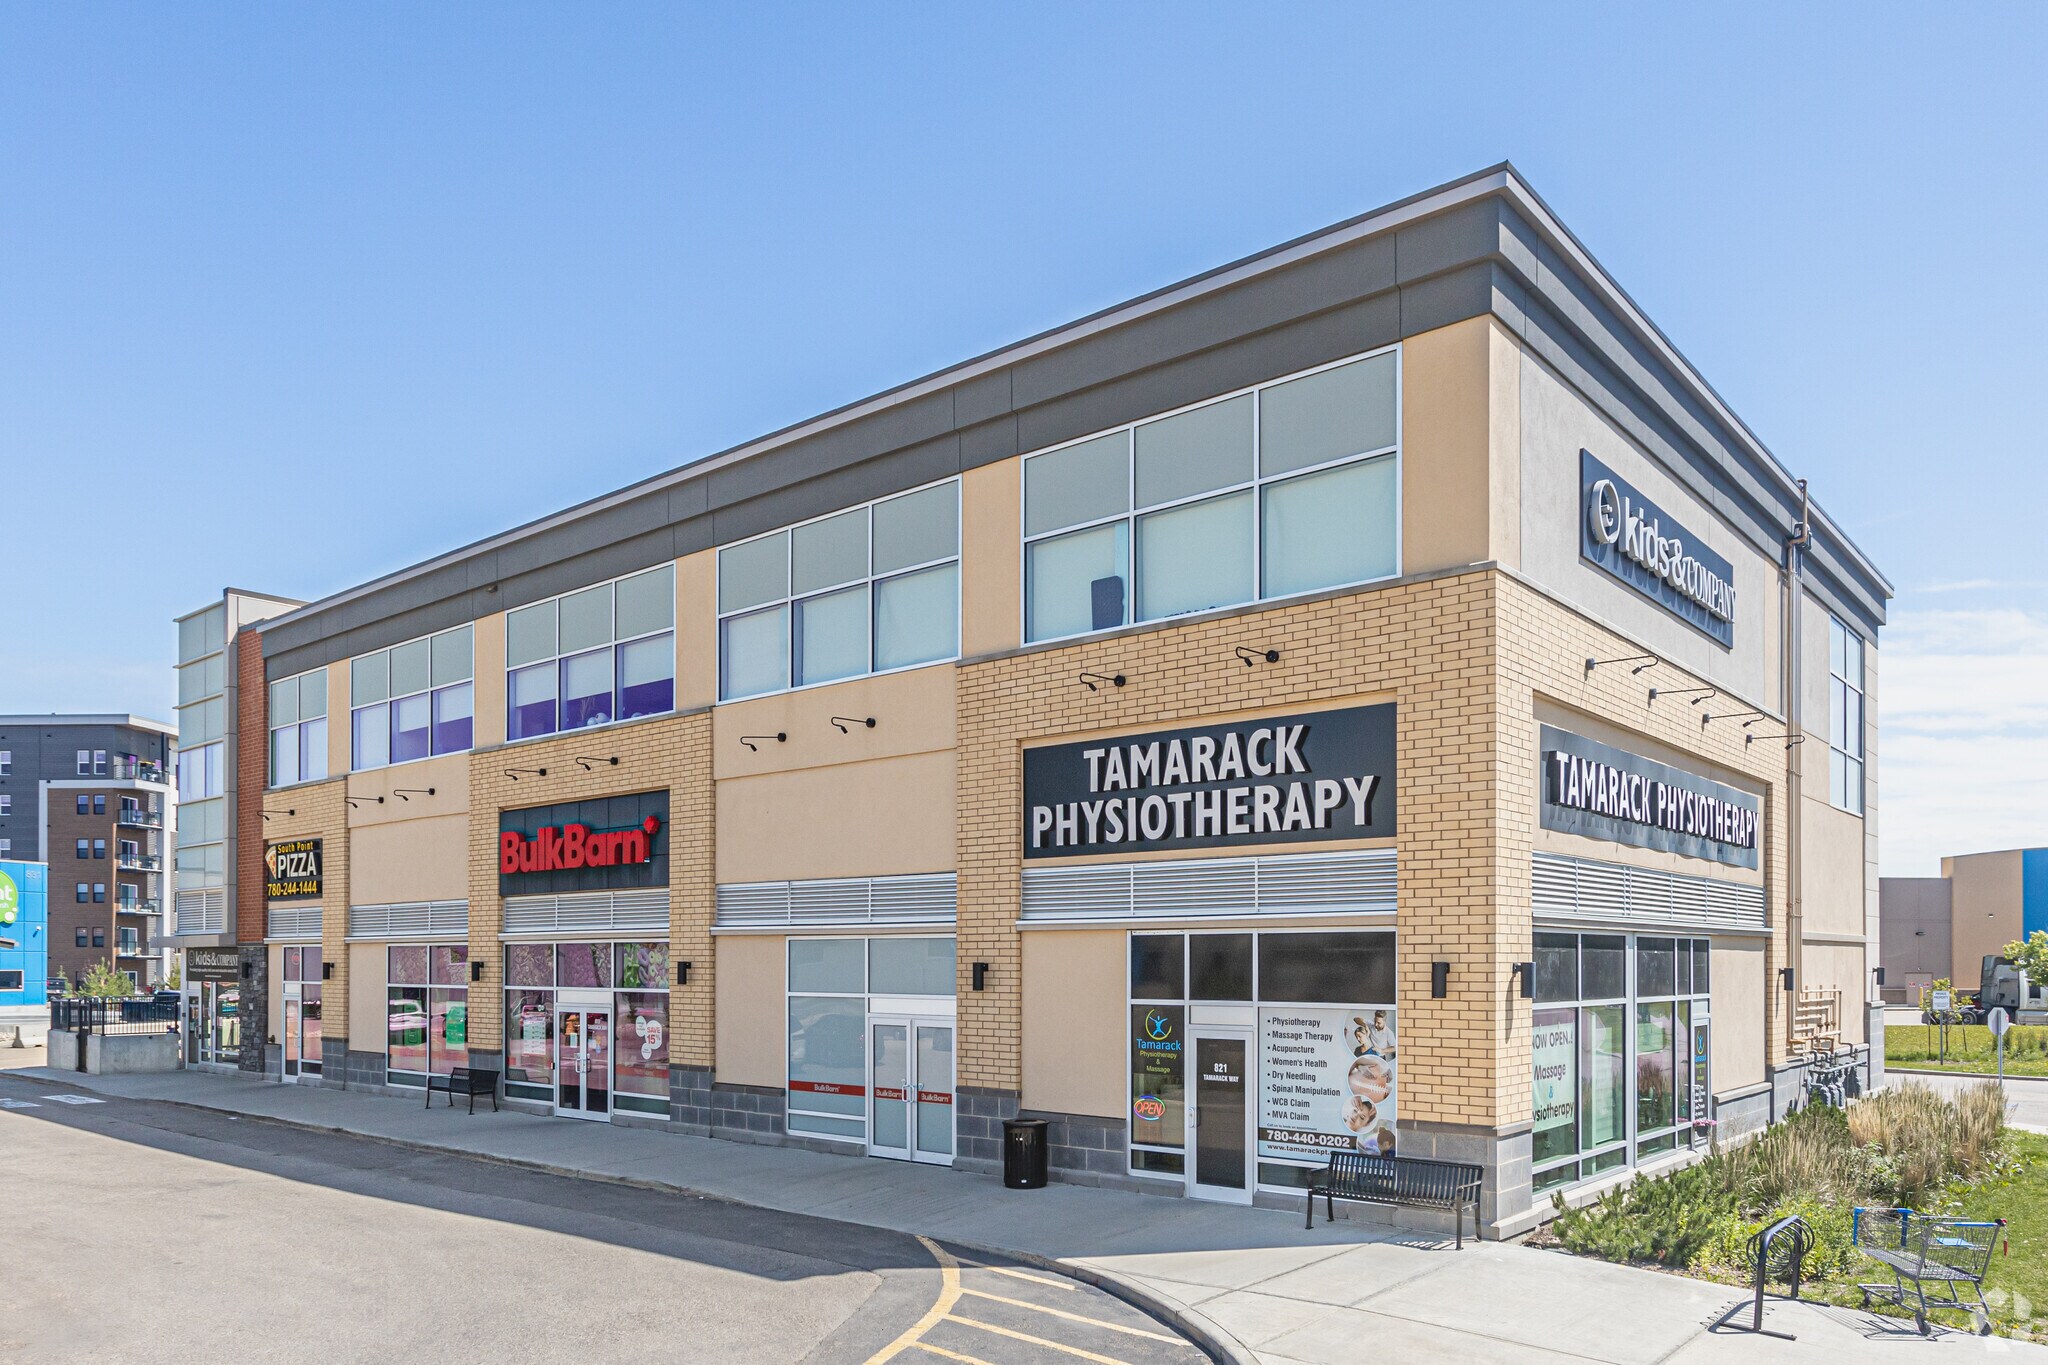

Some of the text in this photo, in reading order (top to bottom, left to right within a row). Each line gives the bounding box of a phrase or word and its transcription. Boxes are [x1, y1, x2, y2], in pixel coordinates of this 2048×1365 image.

[1083, 724, 1309, 793] TAMARACK
[1553, 750, 1760, 849] TAMARACK PHYSIOTHERAPY
[1033, 774, 1379, 848] PHYSIOTHERAPY
[277, 841, 313, 854] South Point
[500, 824, 650, 875] BulkBarn
[277, 851, 317, 879] PIZZA
[267, 880, 317, 897] 780-244-1444
[1272, 1017, 1321, 1028] Physiotherapy
[646, 1026, 661, 1034] SAVE
[1272, 1030, 1333, 1042] Massage Therapy
[1136, 1038, 1182, 1051] Tamarack
[1272, 1044, 1315, 1053] Acupuncture
[1139, 1050, 1177, 1060] Physiotherapy
[1213, 1063, 1228, 1073] 821
[1272, 1057, 1328, 1067] Women's Health
[1146, 1065, 1171, 1074] Massage
[1533, 1063, 1567, 1081] Massage
[1203, 1074, 1228, 1082] TAMARACK
[1272, 1070, 1316, 1082] Dry Needling
[814, 1083, 839, 1093] BulkBarn
[1272, 1084, 1341, 1097] Spinal Manipulation
[920, 1092, 949, 1102] BulkBarn
[1272, 1097, 1310, 1107] WCB Claim
[1135, 1101, 1162, 1117] OPEN
[1272, 1110, 1310, 1121] MVA Claim
[1266, 1129, 1350, 1148] 780-440-0202
[1267, 1144, 1332, 1156] www.tamarackpt.
